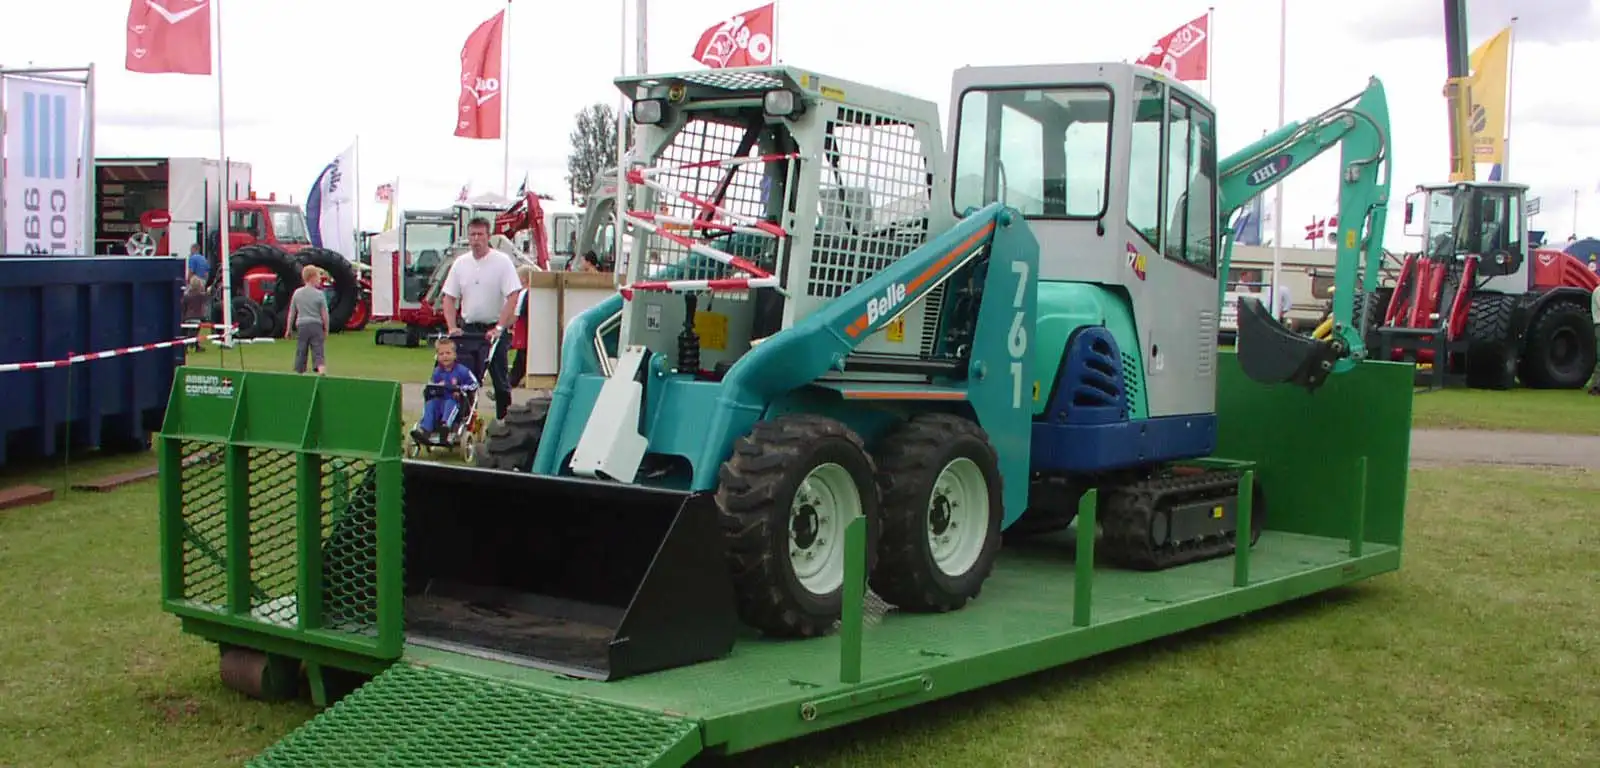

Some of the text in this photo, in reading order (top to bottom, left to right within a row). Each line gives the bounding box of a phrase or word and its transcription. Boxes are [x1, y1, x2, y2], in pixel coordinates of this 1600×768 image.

[1252, 162, 1277, 184] IHI
[867, 283, 905, 325] Belle
[1007, 260, 1029, 409] 761
[185, 385, 234, 395] container
